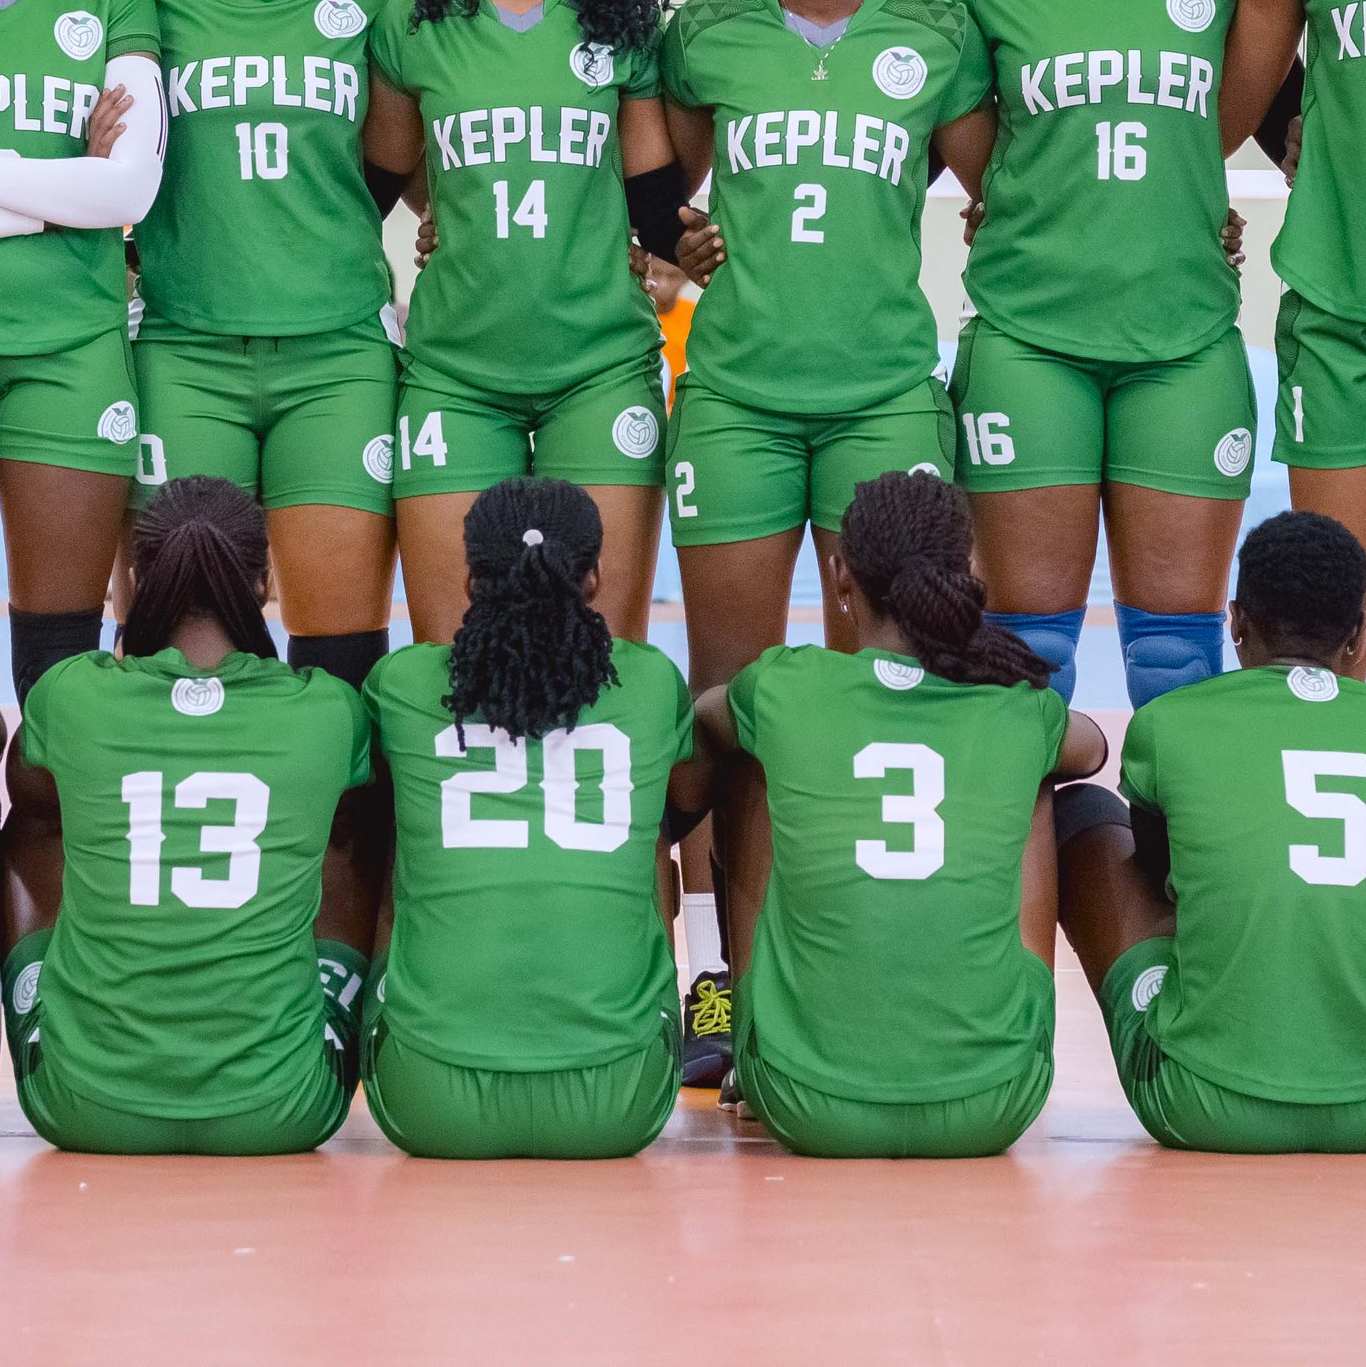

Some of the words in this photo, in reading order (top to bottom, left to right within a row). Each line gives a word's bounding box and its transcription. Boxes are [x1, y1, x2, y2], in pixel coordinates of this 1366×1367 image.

[168, 55, 360, 123] KEPLER
[1021, 50, 1215, 119] KEPLER
[235, 121, 289, 180] 10
[432, 105, 611, 170] KEPLER
[727, 109, 911, 188] KEPLER
[1095, 121, 1148, 181] 16
[492, 180, 548, 239] 14
[790, 183, 828, 243] 2
[399, 411, 449, 471] 14
[961, 411, 1017, 465] 16
[1292, 385, 1305, 443] 1
[674, 461, 699, 518] 2
[434, 722, 633, 853] 20
[852, 742, 946, 880] 3
[120, 770, 271, 909] 13
